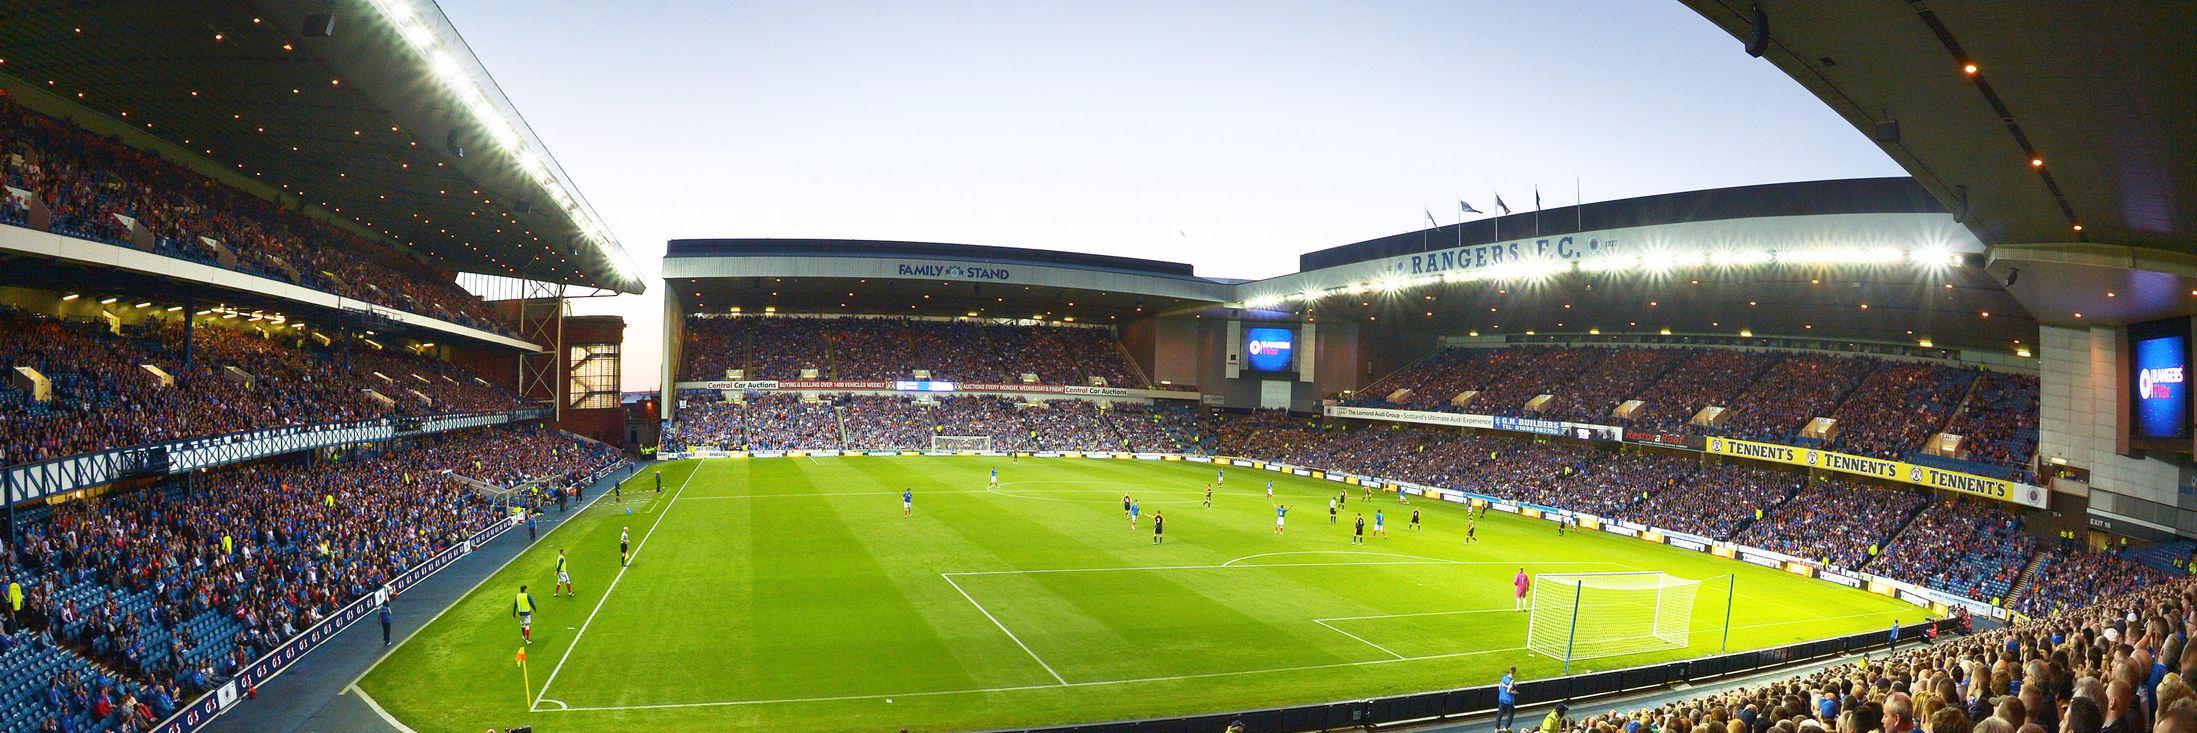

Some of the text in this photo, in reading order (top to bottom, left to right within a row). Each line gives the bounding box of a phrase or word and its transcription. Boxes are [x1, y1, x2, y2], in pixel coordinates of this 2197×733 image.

[1411, 242, 1519, 274] RANGERS
[898, 264, 1010, 280] FAMILY STAND
[2152, 367, 2184, 383] RANGERS
[1049, 385, 1065, 393] FRIDAY
[1065, 386, 1088, 394] Central
[1101, 387, 1128, 396] Auctions
[1356, 409, 1375, 417] Lomond
[1375, 410, 1386, 418] Audi
[1386, 411, 1401, 419] Group
[1403, 412, 1428, 421] Scotland's
[1428, 414, 1450, 422] Ultimate
[1450, 415, 1463, 423] Audi
[1463, 416, 1492, 426] Experience
[1519, 418, 1560, 430] BUILDERS
[1728, 441, 1794, 461] TENNENT'S
[1824, 453, 1896, 477] TENNENT'S
[1929, 470, 2005, 497] TENNENT'S
[2090, 518, 2104, 527] EXIT
